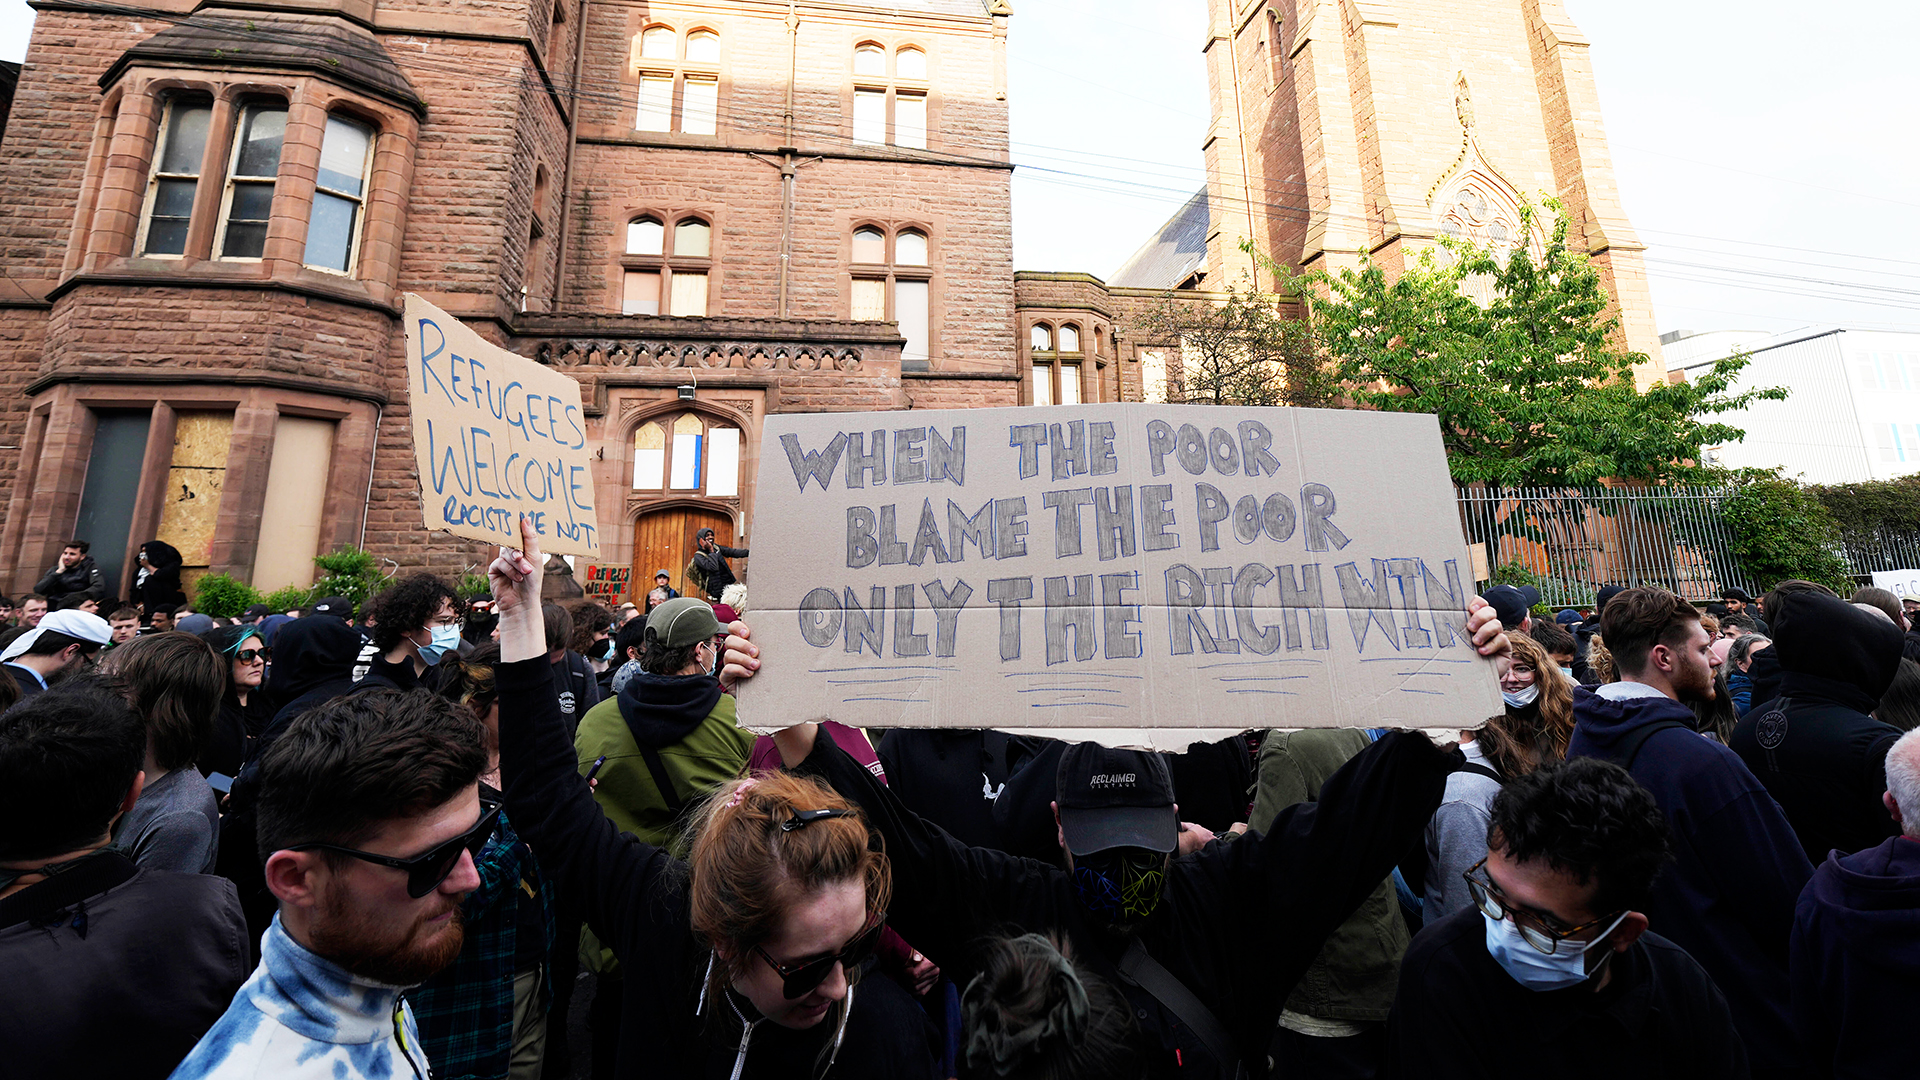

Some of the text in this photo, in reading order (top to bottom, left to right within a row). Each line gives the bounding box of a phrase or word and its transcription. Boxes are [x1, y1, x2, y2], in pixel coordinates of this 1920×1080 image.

[418, 318, 585, 450] REFUGEES
[427, 418, 593, 524] WELCOME
[779, 419, 1281, 493] WHEN THE POOR
[443, 494, 512, 537] RACISTS
[555, 519, 599, 549] NOT.
[846, 482, 1353, 568] BLAME THE POOR
[584, 581, 627, 595] WELCOME
[587, 565, 630, 582] REFUGEES
[1890, 579, 1920, 599] ELC
[798, 557, 1475, 667] ONLY THE RICH WIN
[1090, 773, 1136, 785] RECLAIMED
